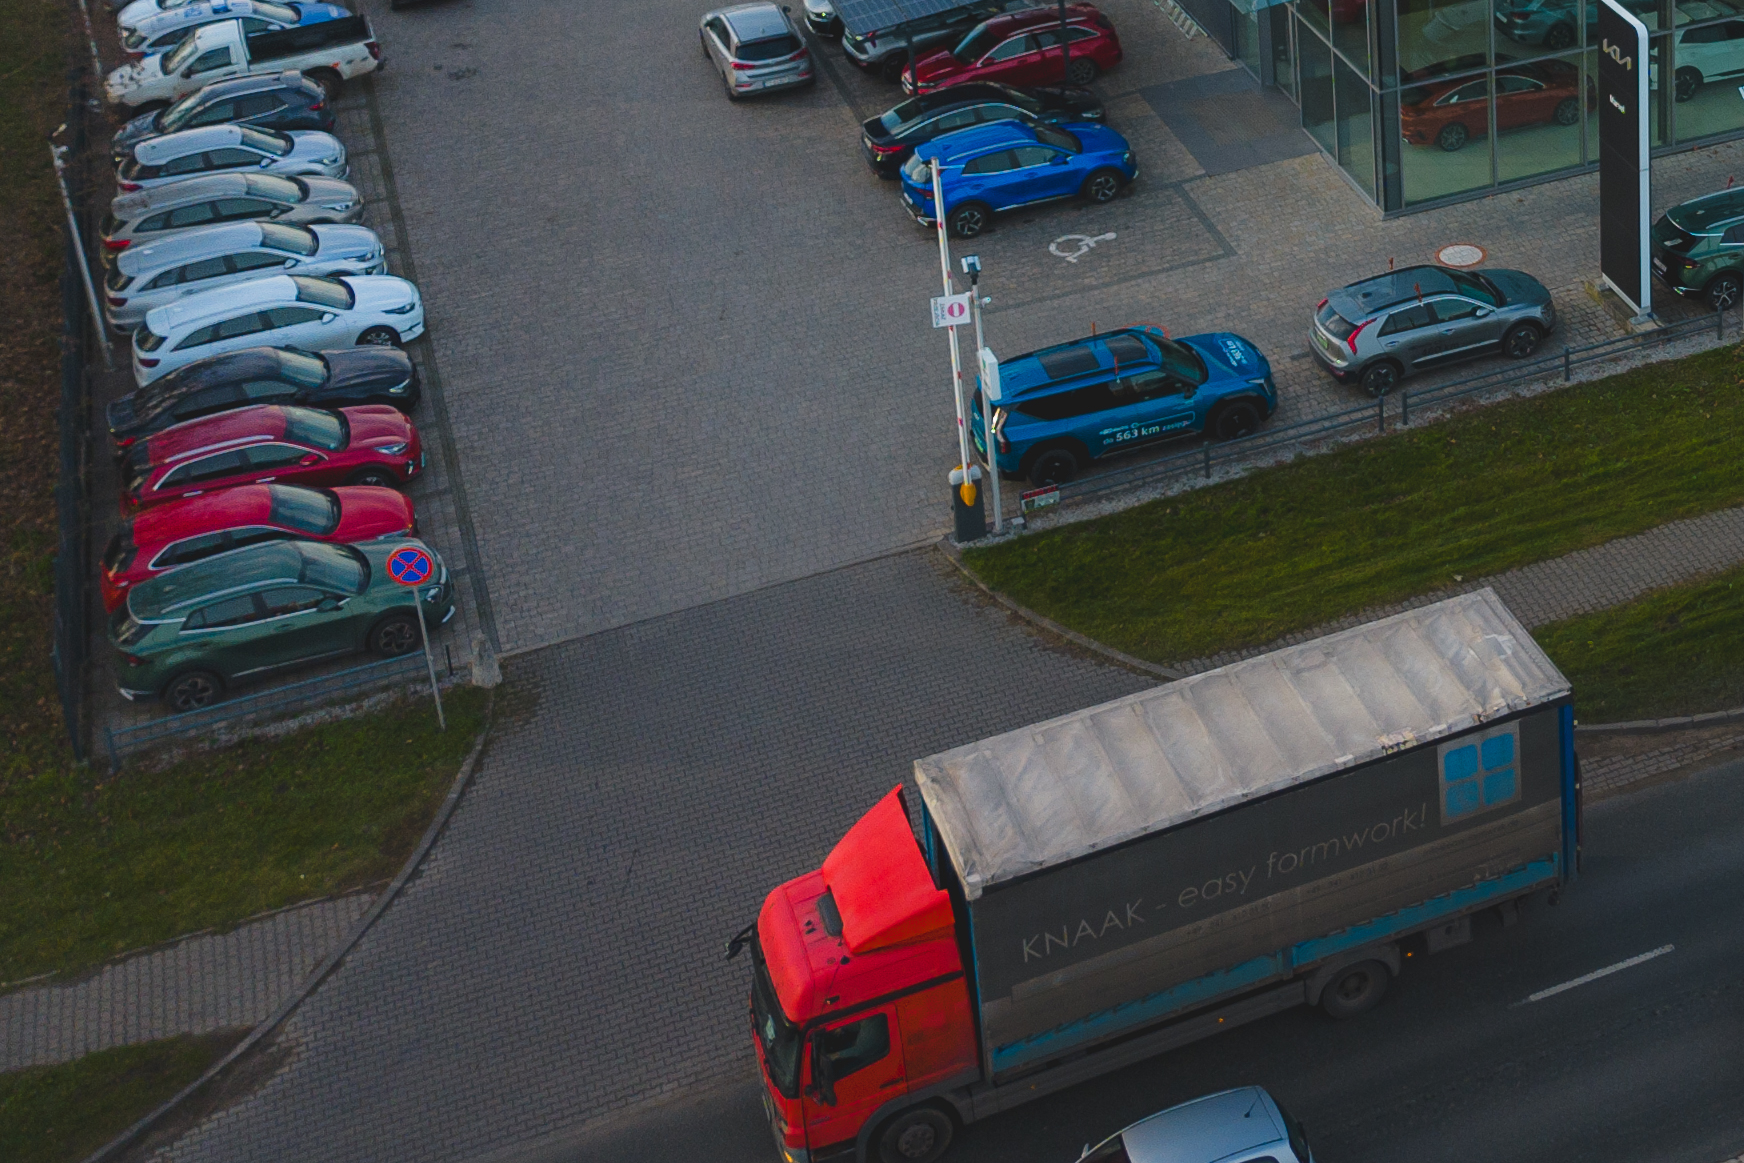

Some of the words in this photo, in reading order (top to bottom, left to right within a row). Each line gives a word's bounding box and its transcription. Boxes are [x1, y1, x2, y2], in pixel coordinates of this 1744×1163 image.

[1116, 428, 1138, 442] 563
[1141, 424, 1160, 437] km
[1021, 897, 1145, 963] KNAAK
[1178, 863, 1256, 908] easy
[1266, 802, 1427, 879] formwork!
